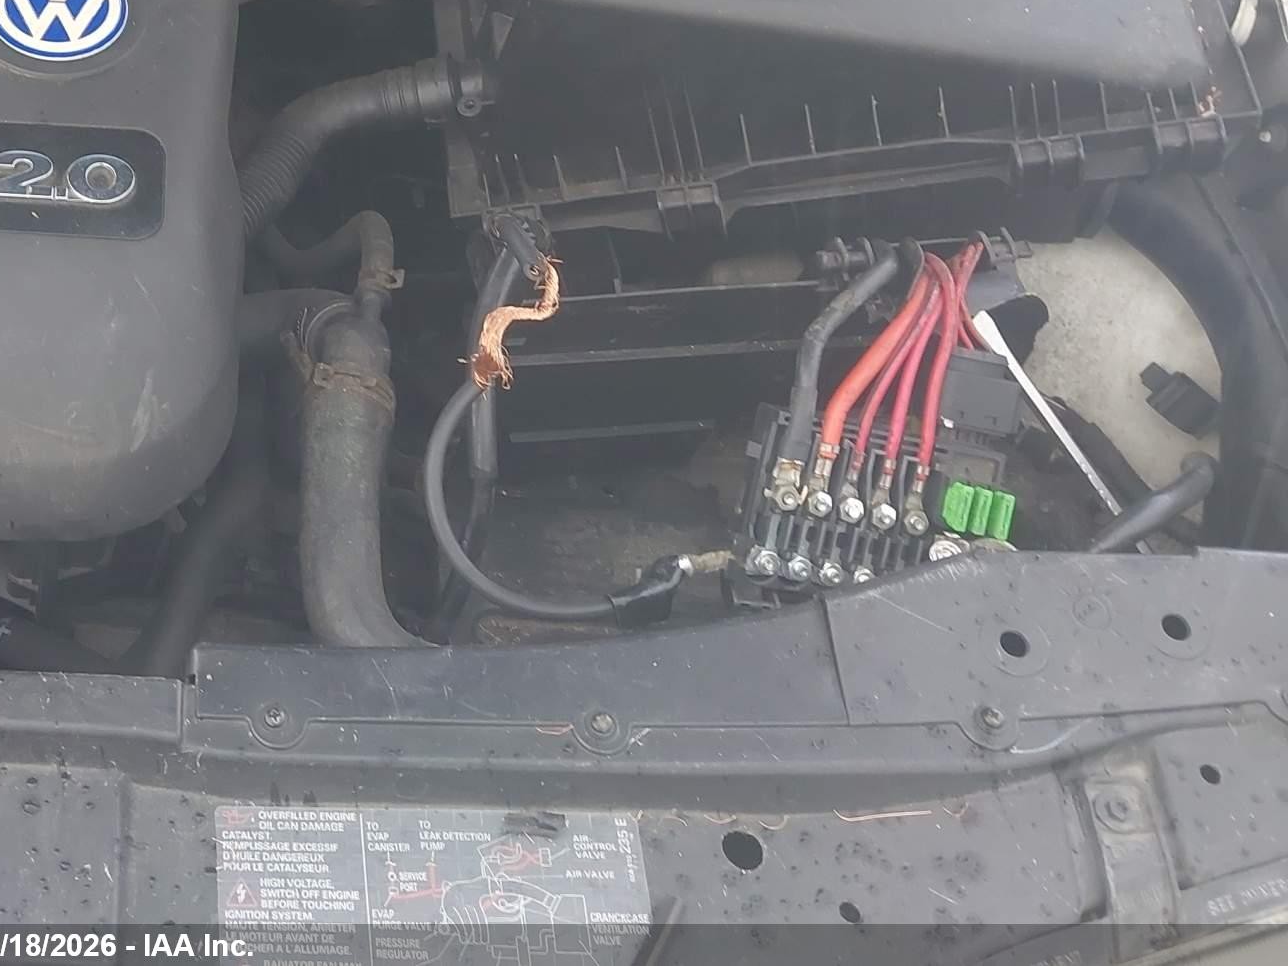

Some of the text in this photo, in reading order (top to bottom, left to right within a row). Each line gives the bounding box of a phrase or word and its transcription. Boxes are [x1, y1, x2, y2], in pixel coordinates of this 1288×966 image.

[259, 811, 357, 822] OVERFILLED ENGINE
[259, 821, 344, 832] OIL CAN DAMAGE
[366, 821, 379, 831] TO
[419, 820, 431, 829] TO
[222, 831, 272, 840] CATALYST.
[367, 832, 389, 841] EVAP
[420, 832, 491, 842] LEAK DETECTION
[222, 841, 338, 852] REMPLISSAGE EXCESSIF
[368, 843, 410, 852] CANISTER
[420, 842, 445, 851] PUMP
[574, 843, 617, 851] CONTROL
[262, 852, 324, 862] DANGEREUX
[222, 862, 251, 871] POUR
[253, 863, 264, 872] LE
[399, 872, 428, 882] SERVICE
[566, 870, 615, 879] AIR VALVE
[260, 879, 285, 888] HIGH
[400, 883, 418, 892] PORT
[260, 889, 360, 900] SWITCH OFF ENGINE
[261, 900, 355, 911] BEFORE TOUCHING
[225, 910, 269, 920] IGNITION
[372, 909, 395, 918] EVAP
[225, 921, 259, 931] HAUTE
[373, 922, 432, 932] PURGE VALVE
[591, 925, 651, 936] VENTILATION
[226, 932, 335, 944] LE MOTEUR AVANT DE
[376, 938, 421, 948] PRESSURE
[593, 936, 622, 946] VALVE
[276, 944, 284, 953] A
[376, 949, 429, 960] REGULATOR
